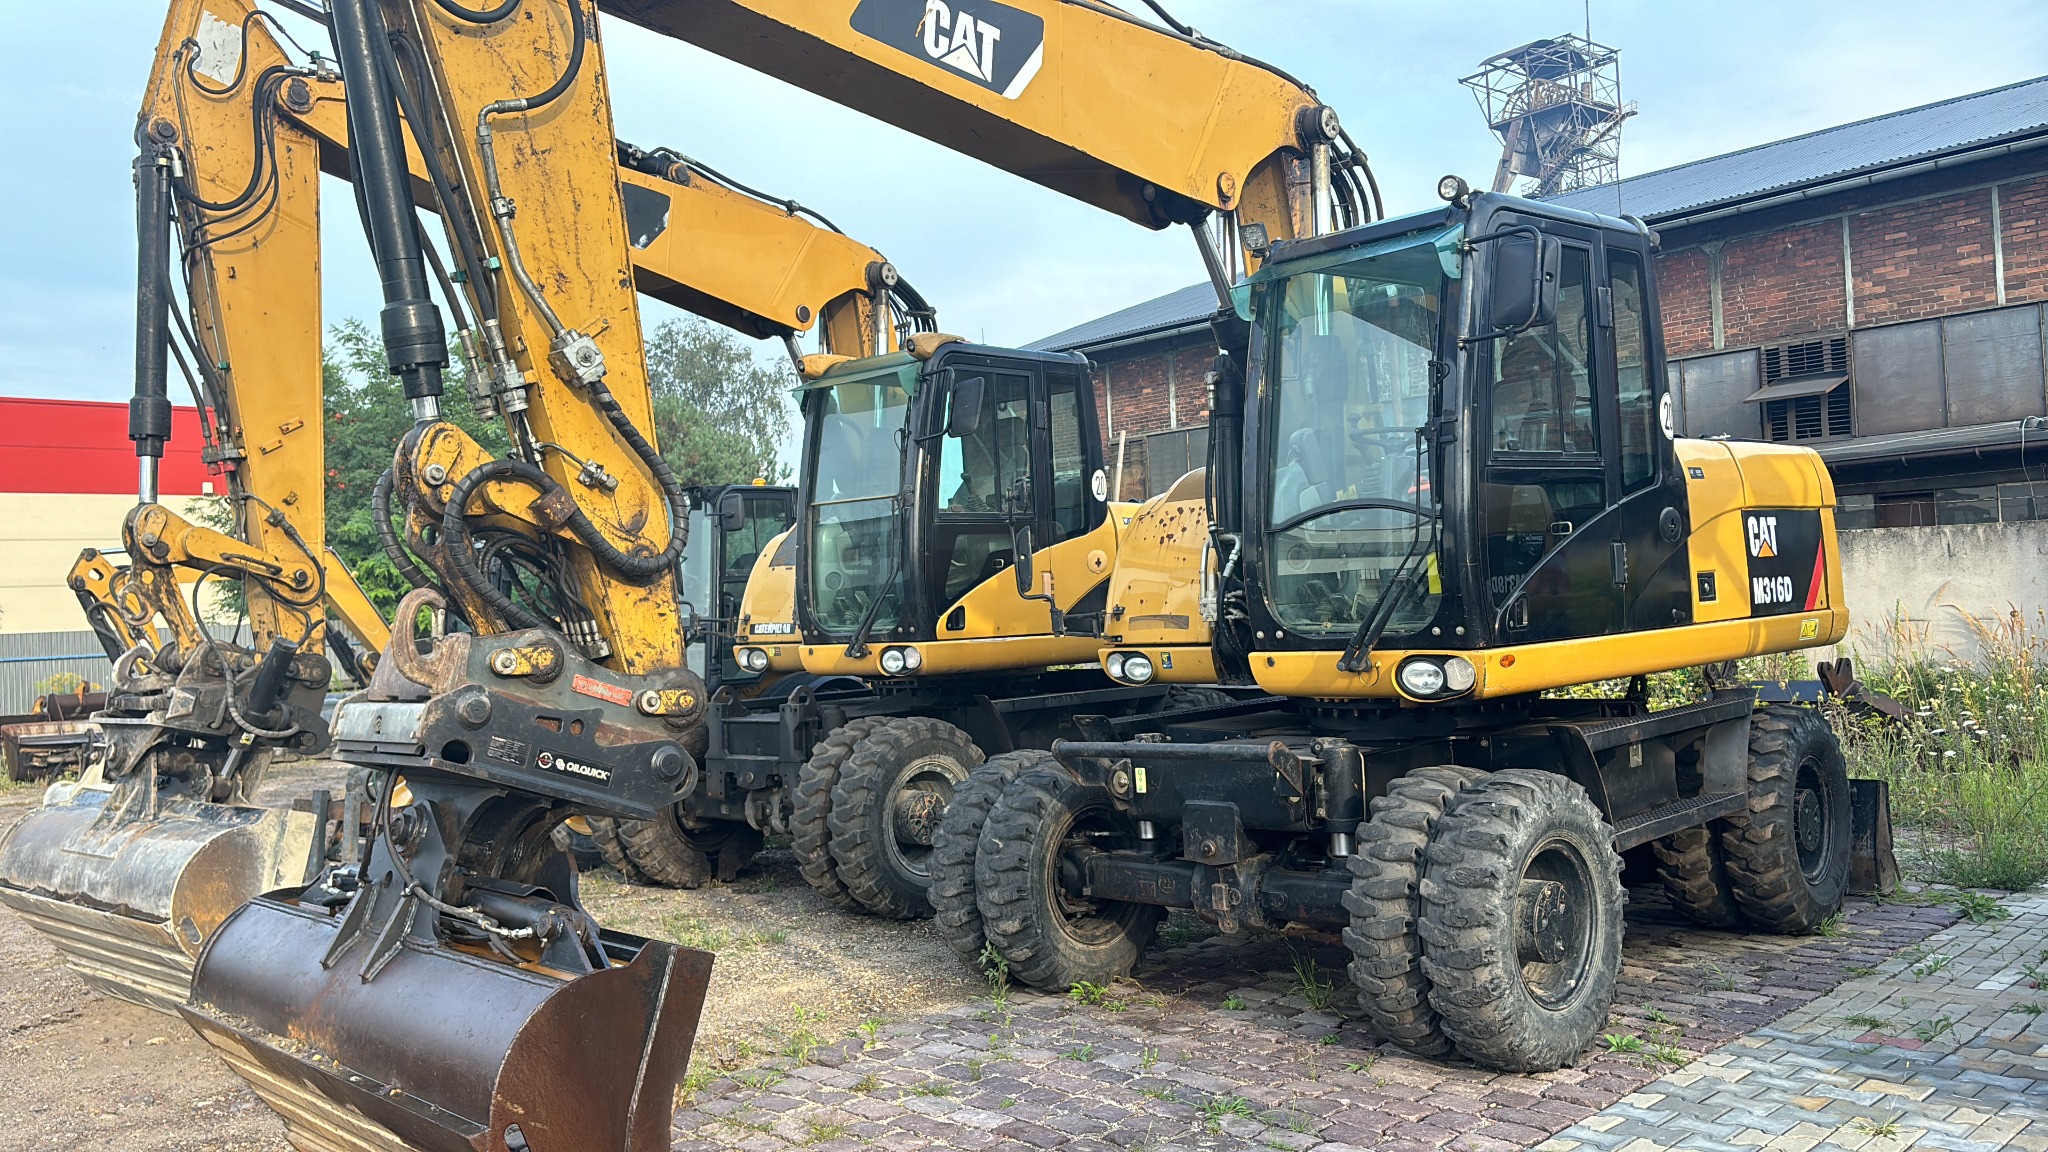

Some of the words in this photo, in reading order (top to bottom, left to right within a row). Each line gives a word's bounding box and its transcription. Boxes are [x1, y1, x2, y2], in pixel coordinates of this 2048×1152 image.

[924, 0, 1000, 82] CAT
[1095, 475, 1105, 496] 20
[1747, 516, 1777, 557] CAT
[1752, 576, 1793, 604] M316D
